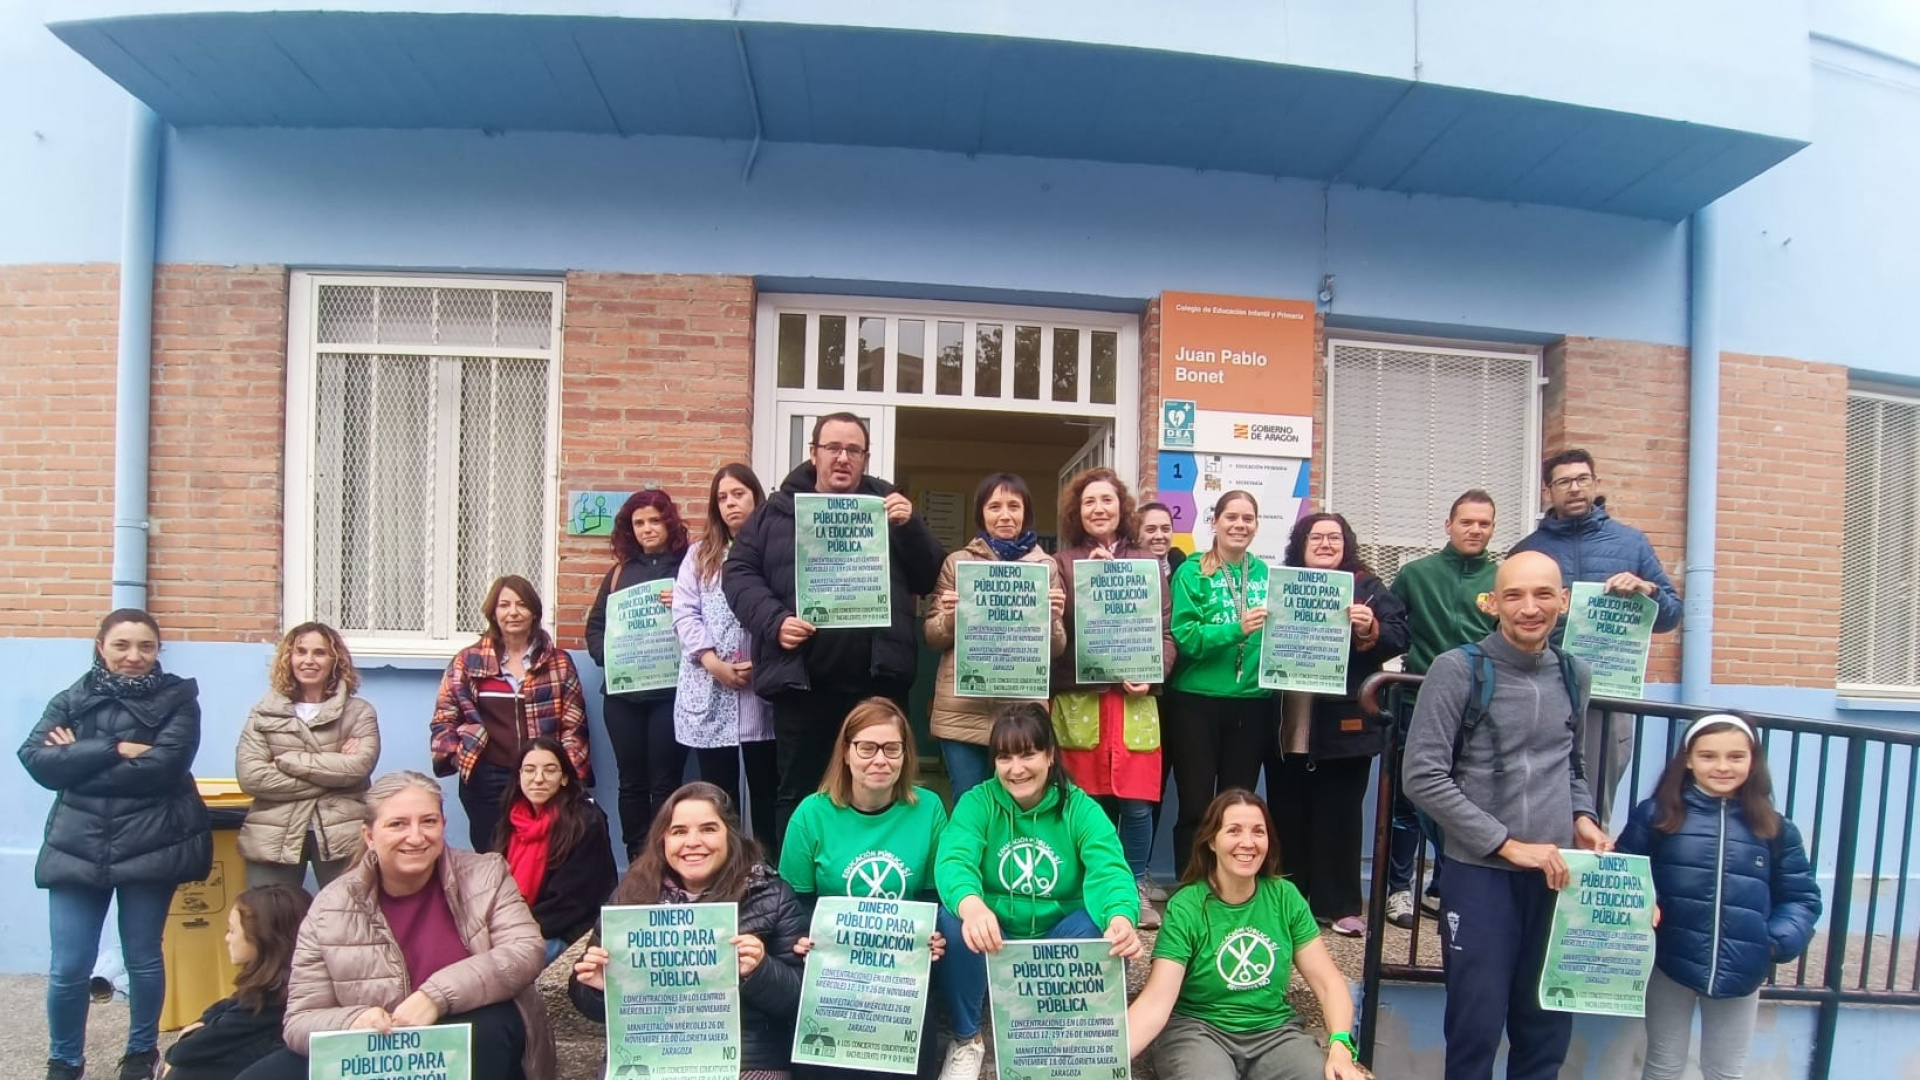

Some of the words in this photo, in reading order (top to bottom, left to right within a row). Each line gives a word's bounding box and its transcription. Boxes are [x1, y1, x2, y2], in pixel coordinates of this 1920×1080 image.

[1176, 304, 1201, 313] Colegio
[1277, 312, 1304, 320] Primaria
[1175, 347, 1215, 363] Juan
[1221, 349, 1267, 366] Pablo
[1176, 367, 1224, 384] Bonet
[1166, 430, 1191, 438] DEA
[1251, 424, 1293, 434] GOBIERNO
[1173, 464, 1182, 478] 1
[828, 498, 858, 510] DINERO
[814, 511, 849, 524] PÚBLICO
[851, 513, 872, 524] PARA
[1172, 506, 1182, 519] 2
[816, 527, 825, 538] LA
[829, 525, 873, 538] EDUCACIÓN
[828, 539, 862, 552] PÚBLICA
[990, 566, 1021, 577] DINERO
[1104, 562, 1132, 573] DINERO
[1091, 575, 1123, 587] PÚBLICO
[1126, 575, 1146, 586] PARA
[1298, 572, 1327, 583] DINERO
[974, 578, 1010, 592] PÚBLICO
[1013, 581, 1036, 592] PARA
[1283, 583, 1316, 595] PÚBLICO
[1319, 586, 1339, 597] PARA
[976, 596, 987, 606] LA
[990, 594, 1036, 607] EDUCACIÓN
[1093, 591, 1103, 601] LA
[1106, 589, 1147, 600] EDUCACIÓN
[1105, 602, 1137, 614] PÚBLICA
[1284, 597, 1294, 607] LA
[1297, 597, 1339, 610] EDUCACIÓN
[1588, 595, 1620, 609] PÚBLICO
[1623, 601, 1643, 612] PARA
[619, 611, 625, 621] LA
[629, 605, 665, 619] EDUCACIÓN
[988, 608, 1023, 621] PÚBLICA
[1295, 610, 1326, 622] PÚBLICA
[1588, 610, 1597, 619] LA
[1600, 610, 1640, 625] EDUCACIÓN
[628, 618, 657, 630] PÚBLICA
[1597, 621, 1626, 635] PÚBLICA
[1036, 666, 1046, 675] NO
[1581, 872, 1621, 889] PÚBLICO
[1624, 876, 1642, 890] PARA
[1581, 892, 1592, 905] LA
[1596, 892, 1644, 909] EDUCACIÓN
[858, 902, 898, 915] DINERO
[650, 909, 694, 926] DINERO
[836, 912, 883, 930] PÚBLICO
[887, 918, 915, 933] PARA
[1592, 908, 1630, 925] PÚBLICA
[628, 929, 679, 948] PÚBLICO
[684, 929, 715, 946] PARA
[837, 932, 849, 945] LA
[854, 932, 913, 952] EDUCACIÓN
[632, 953, 646, 968] LA
[651, 947, 716, 967] EDUCACIÓN
[850, 948, 895, 969] PÚBLICA
[1033, 945, 1078, 960] DINERO
[822, 968, 872, 980] CONCENTRACIONES
[873, 974, 882, 982] EN
[883, 975, 891, 983] LOS
[892, 976, 916, 985] CENTROS
[1013, 962, 1064, 978] PÚBLICO
[1069, 962, 1102, 976] PARA
[651, 969, 700, 986] PÚBLICA
[1018, 982, 1033, 996] LA
[1038, 977, 1104, 996] EDUCACIÓN
[1633, 980, 1644, 991] NO
[624, 994, 678, 1003] CONCENTRACIONES
[679, 994, 687, 1002] EN
[700, 992, 725, 1001] CENTROS
[887, 987, 919, 998] NOVIEMBRE
[665, 1006, 672, 1014] 19
[687, 1005, 694, 1013] DE
[696, 1004, 730, 1012] NOVIEMBRE
[820, 996, 864, 1008] MANIFESTACIÓN
[903, 1005, 911, 1013] DE
[1037, 998, 1088, 1013] PÚBLICA
[815, 1008, 847, 1018] NOVIEMBRE
[848, 1023, 876, 1033] ZARAGOZA
[1011, 1019, 1065, 1027] CONCENTRACIONES
[1088, 1018, 1114, 1026] CENTROS
[904, 1030, 917, 1043] NO
[1066, 1030, 1073, 1038] 26
[1075, 1030, 1082, 1038] DE
[368, 1032, 421, 1052] DINERO
[723, 1047, 736, 1060] NO
[1016, 1046, 1061, 1054] MANIFESTACIÓN
[1063, 1045, 1095, 1053] MIÉRCOLES
[1097, 1045, 1104, 1053] 26
[1106, 1045, 1113, 1053] DE
[341, 1055, 402, 1076] PÚBLICO
[409, 1052, 445, 1070] PARA
[1014, 1058, 1047, 1066] NOVIEMBRE
[1068, 1057, 1096, 1065] GLORIETA
[1051, 1069, 1081, 1077] ZARAGOZA
[1112, 1067, 1126, 1079] NO
